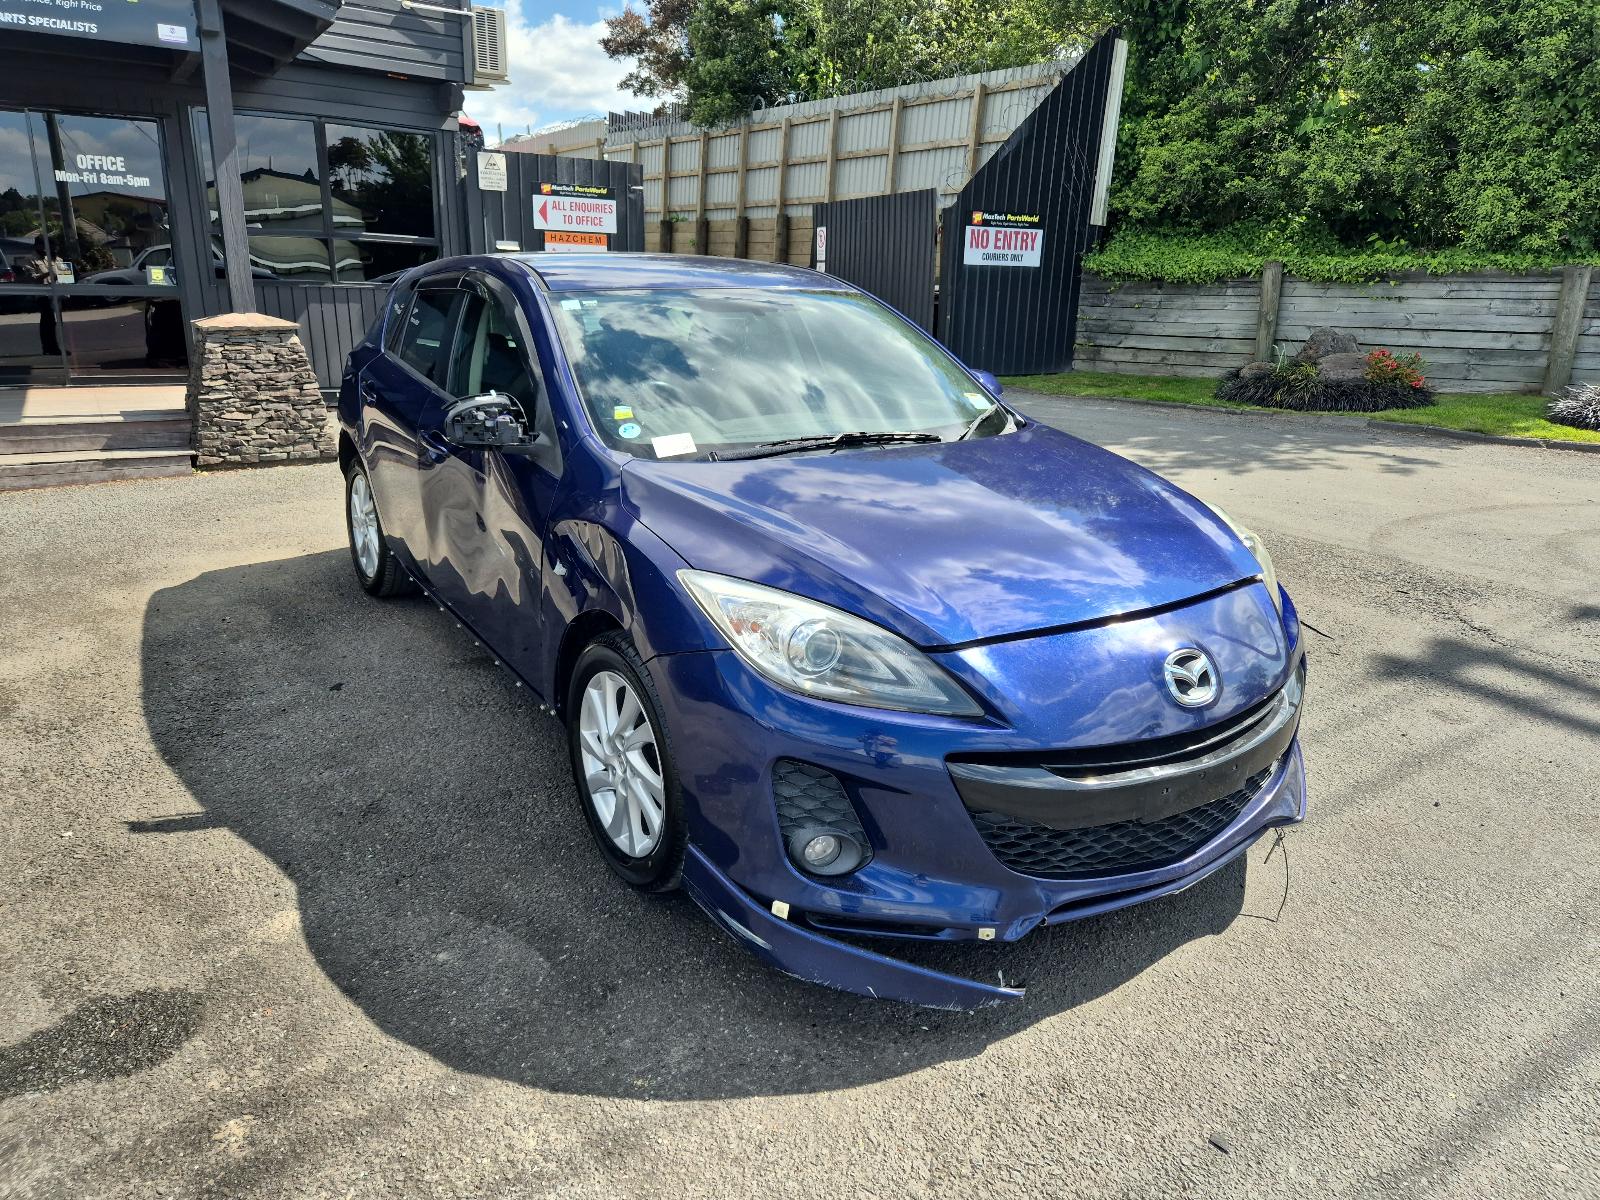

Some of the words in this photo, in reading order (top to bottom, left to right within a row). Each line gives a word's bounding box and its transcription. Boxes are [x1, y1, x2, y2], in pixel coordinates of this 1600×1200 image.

[80, 0, 103, 11] Price
[28, 15, 98, 33] SPECIALISTS
[76, 154, 126, 171] OFFICE
[54, 170, 98, 184] Mon-Fri
[99, 173, 150, 188] 8am-5pm
[551, 200, 567, 211] ALL
[569, 201, 613, 214] ENQUIRIES
[562, 214, 573, 225] TO
[575, 215, 604, 227] OFFICE
[1006, 214, 1039, 222] PartsWorld
[550, 234, 602, 244] HAZCHEM
[970, 229, 989, 249] NO
[994, 230, 1038, 251] ENTRY
[982, 252, 1009, 261] COURIERS
[1010, 253, 1024, 263] ONLY
